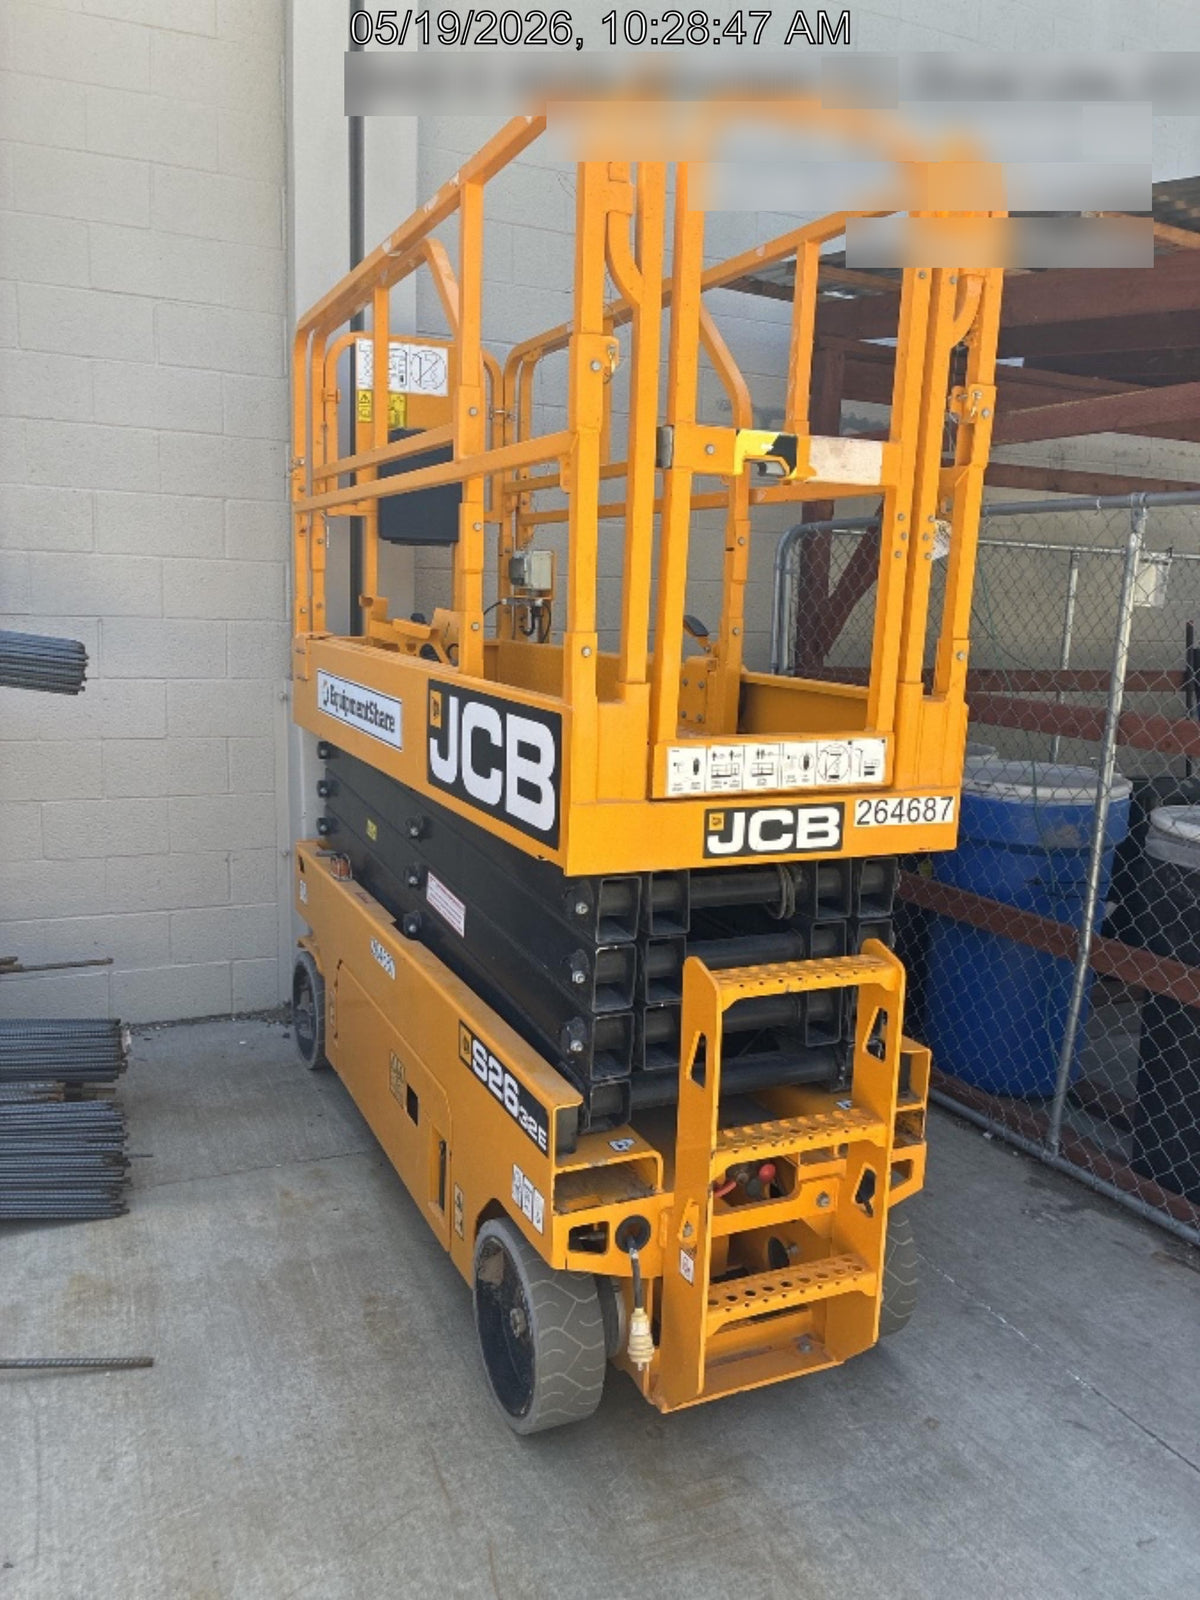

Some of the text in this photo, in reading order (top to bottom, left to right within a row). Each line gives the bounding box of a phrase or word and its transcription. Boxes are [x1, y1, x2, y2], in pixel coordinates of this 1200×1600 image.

[430, 696, 556, 831] JCB
[706, 806, 841, 855] JCB
[856, 796, 954, 826] 264687
